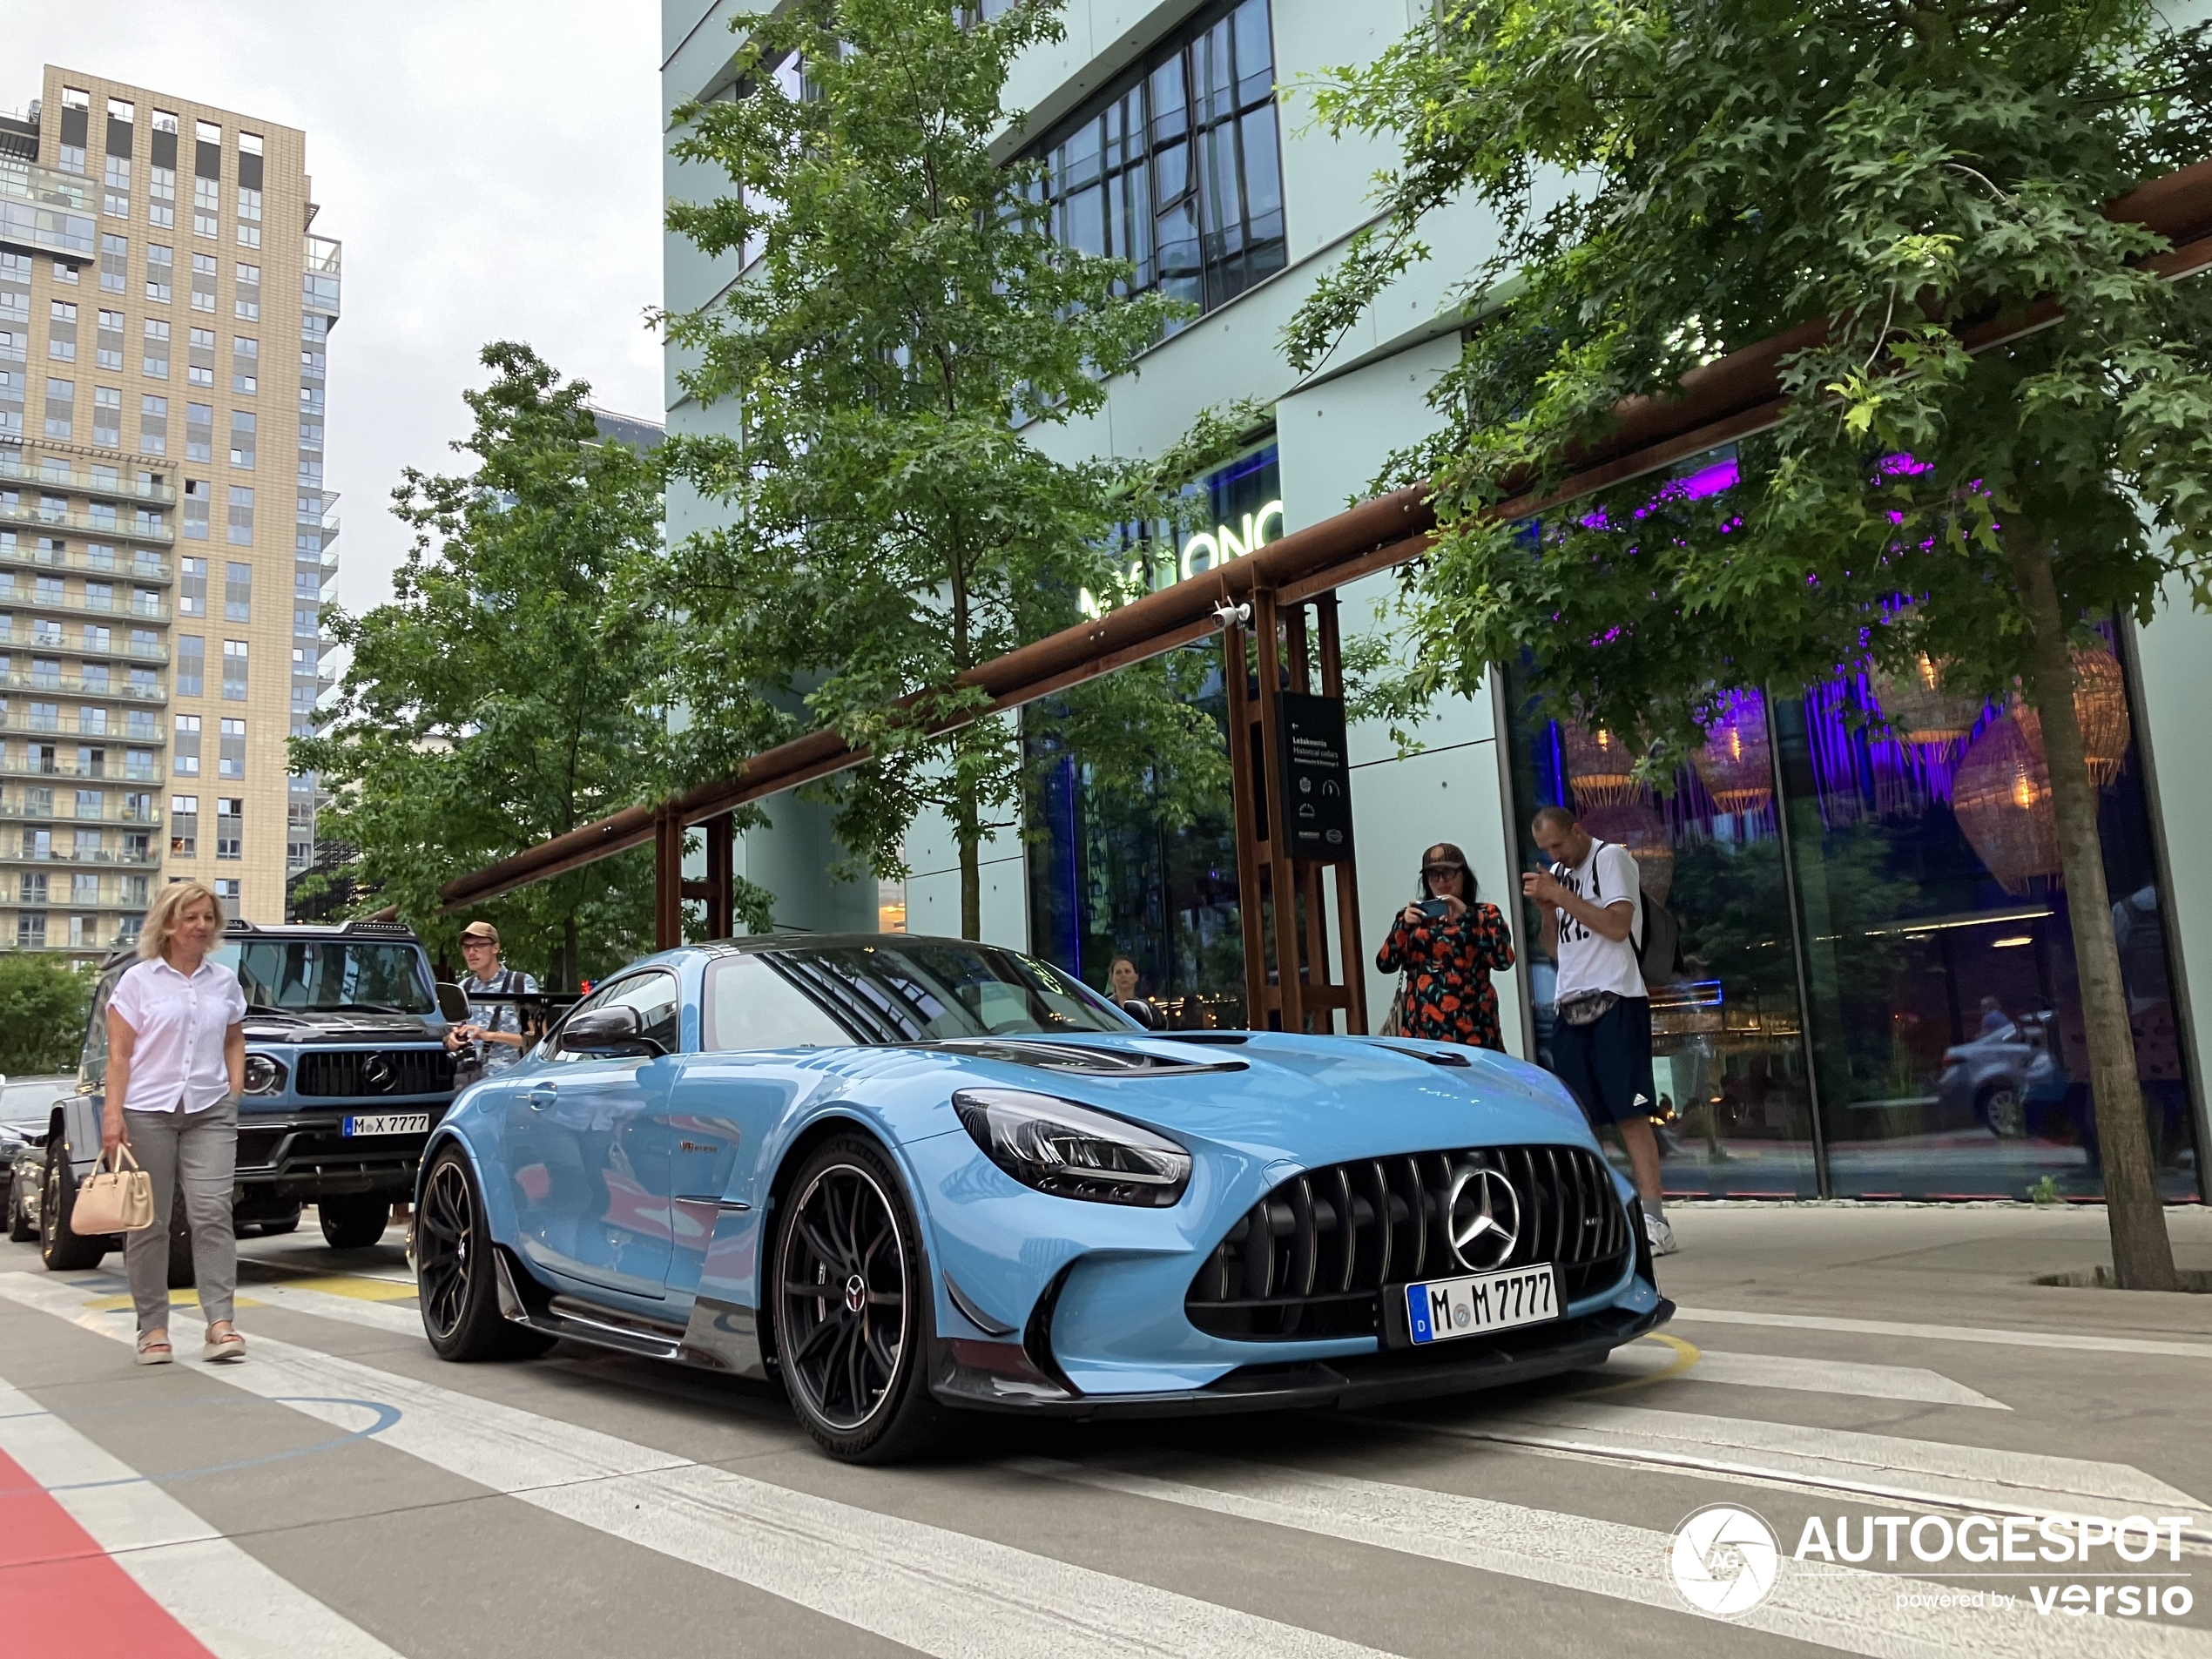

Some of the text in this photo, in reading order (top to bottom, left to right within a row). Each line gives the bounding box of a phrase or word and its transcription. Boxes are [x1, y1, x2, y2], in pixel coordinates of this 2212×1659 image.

[354, 1118, 364, 1133] M
[389, 1116, 427, 1131] 7777
[1418, 1319, 1426, 1332] D
[1430, 1289, 1452, 1332] M
